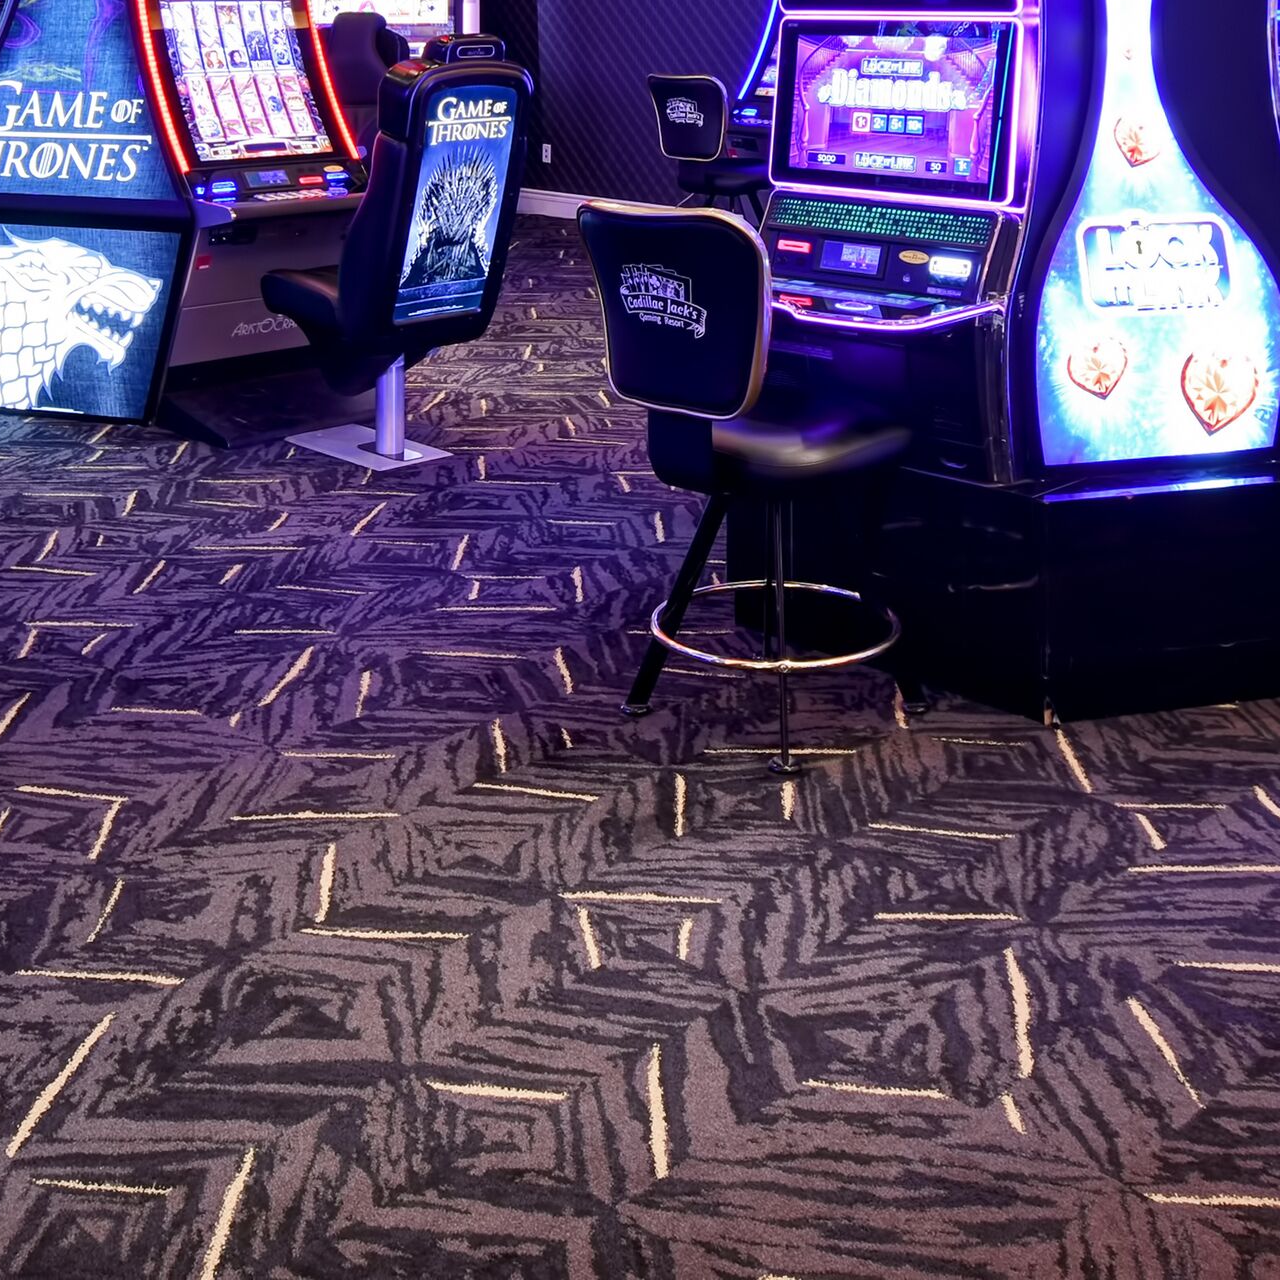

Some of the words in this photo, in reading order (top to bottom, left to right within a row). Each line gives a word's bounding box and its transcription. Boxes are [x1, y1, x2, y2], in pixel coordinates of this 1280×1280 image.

[110, 98, 144, 124] OF
[437, 96, 493, 123] GAME
[493, 101, 508, 113] OF
[428, 115, 512, 146] THRONES
[628, 295, 664, 310] Cadillac
[667, 299, 699, 320] Jack's
[639, 312, 662, 324] Gaming
